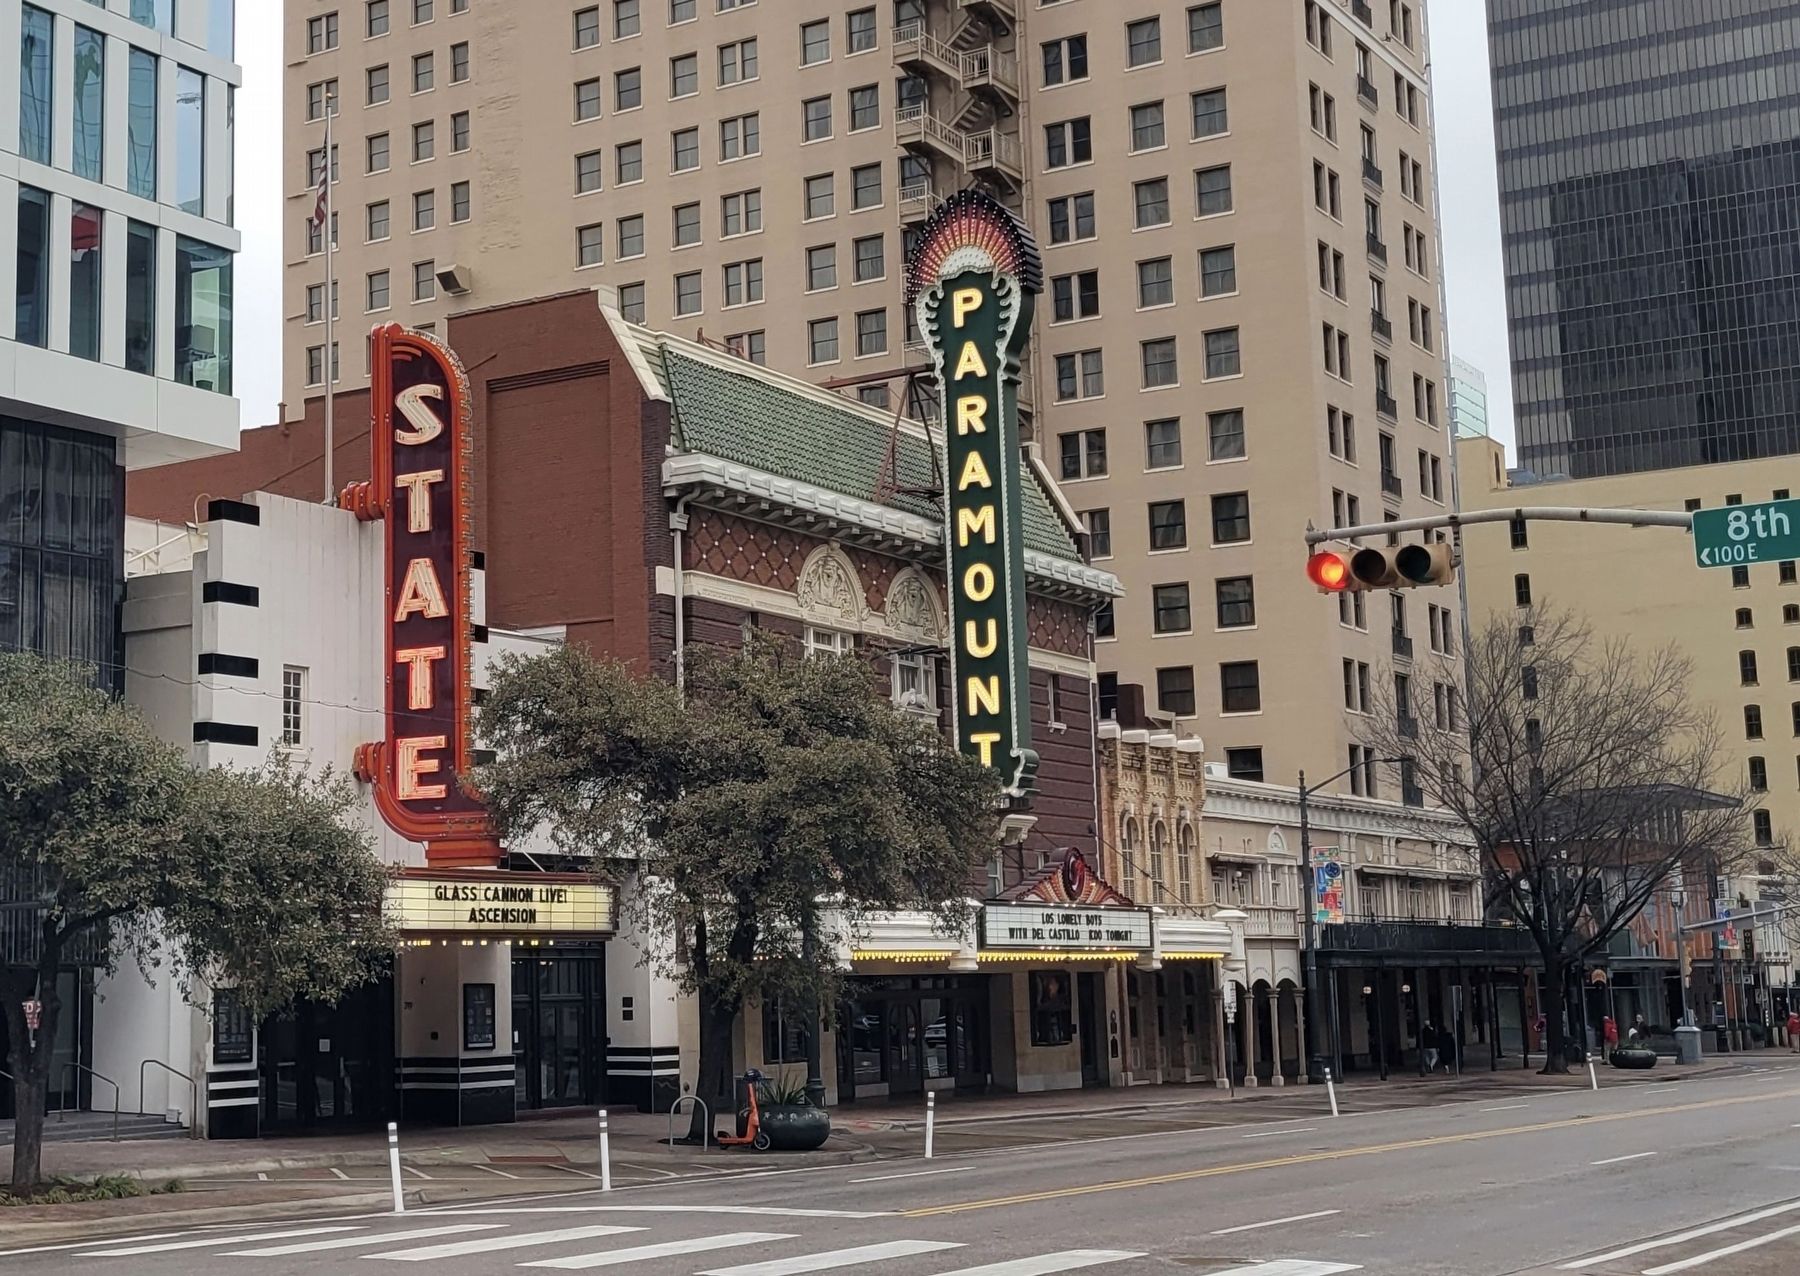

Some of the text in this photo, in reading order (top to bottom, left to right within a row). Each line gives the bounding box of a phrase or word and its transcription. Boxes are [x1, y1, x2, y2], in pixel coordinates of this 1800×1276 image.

[952, 287, 1001, 766] PARAMOUNT
[1728, 507, 1790, 541] 8th
[393, 383, 450, 801] STATE
[434, 885, 477, 901] GLASS
[484, 886, 534, 903] CANNON
[468, 907, 537, 924] ASCENSION
[1041, 912, 1102, 926] LOS LONELY BOYS
[1009, 927, 1027, 939] WITH
[1032, 927, 1045, 940] DEL
[1049, 928, 1080, 941] CASTILLO
